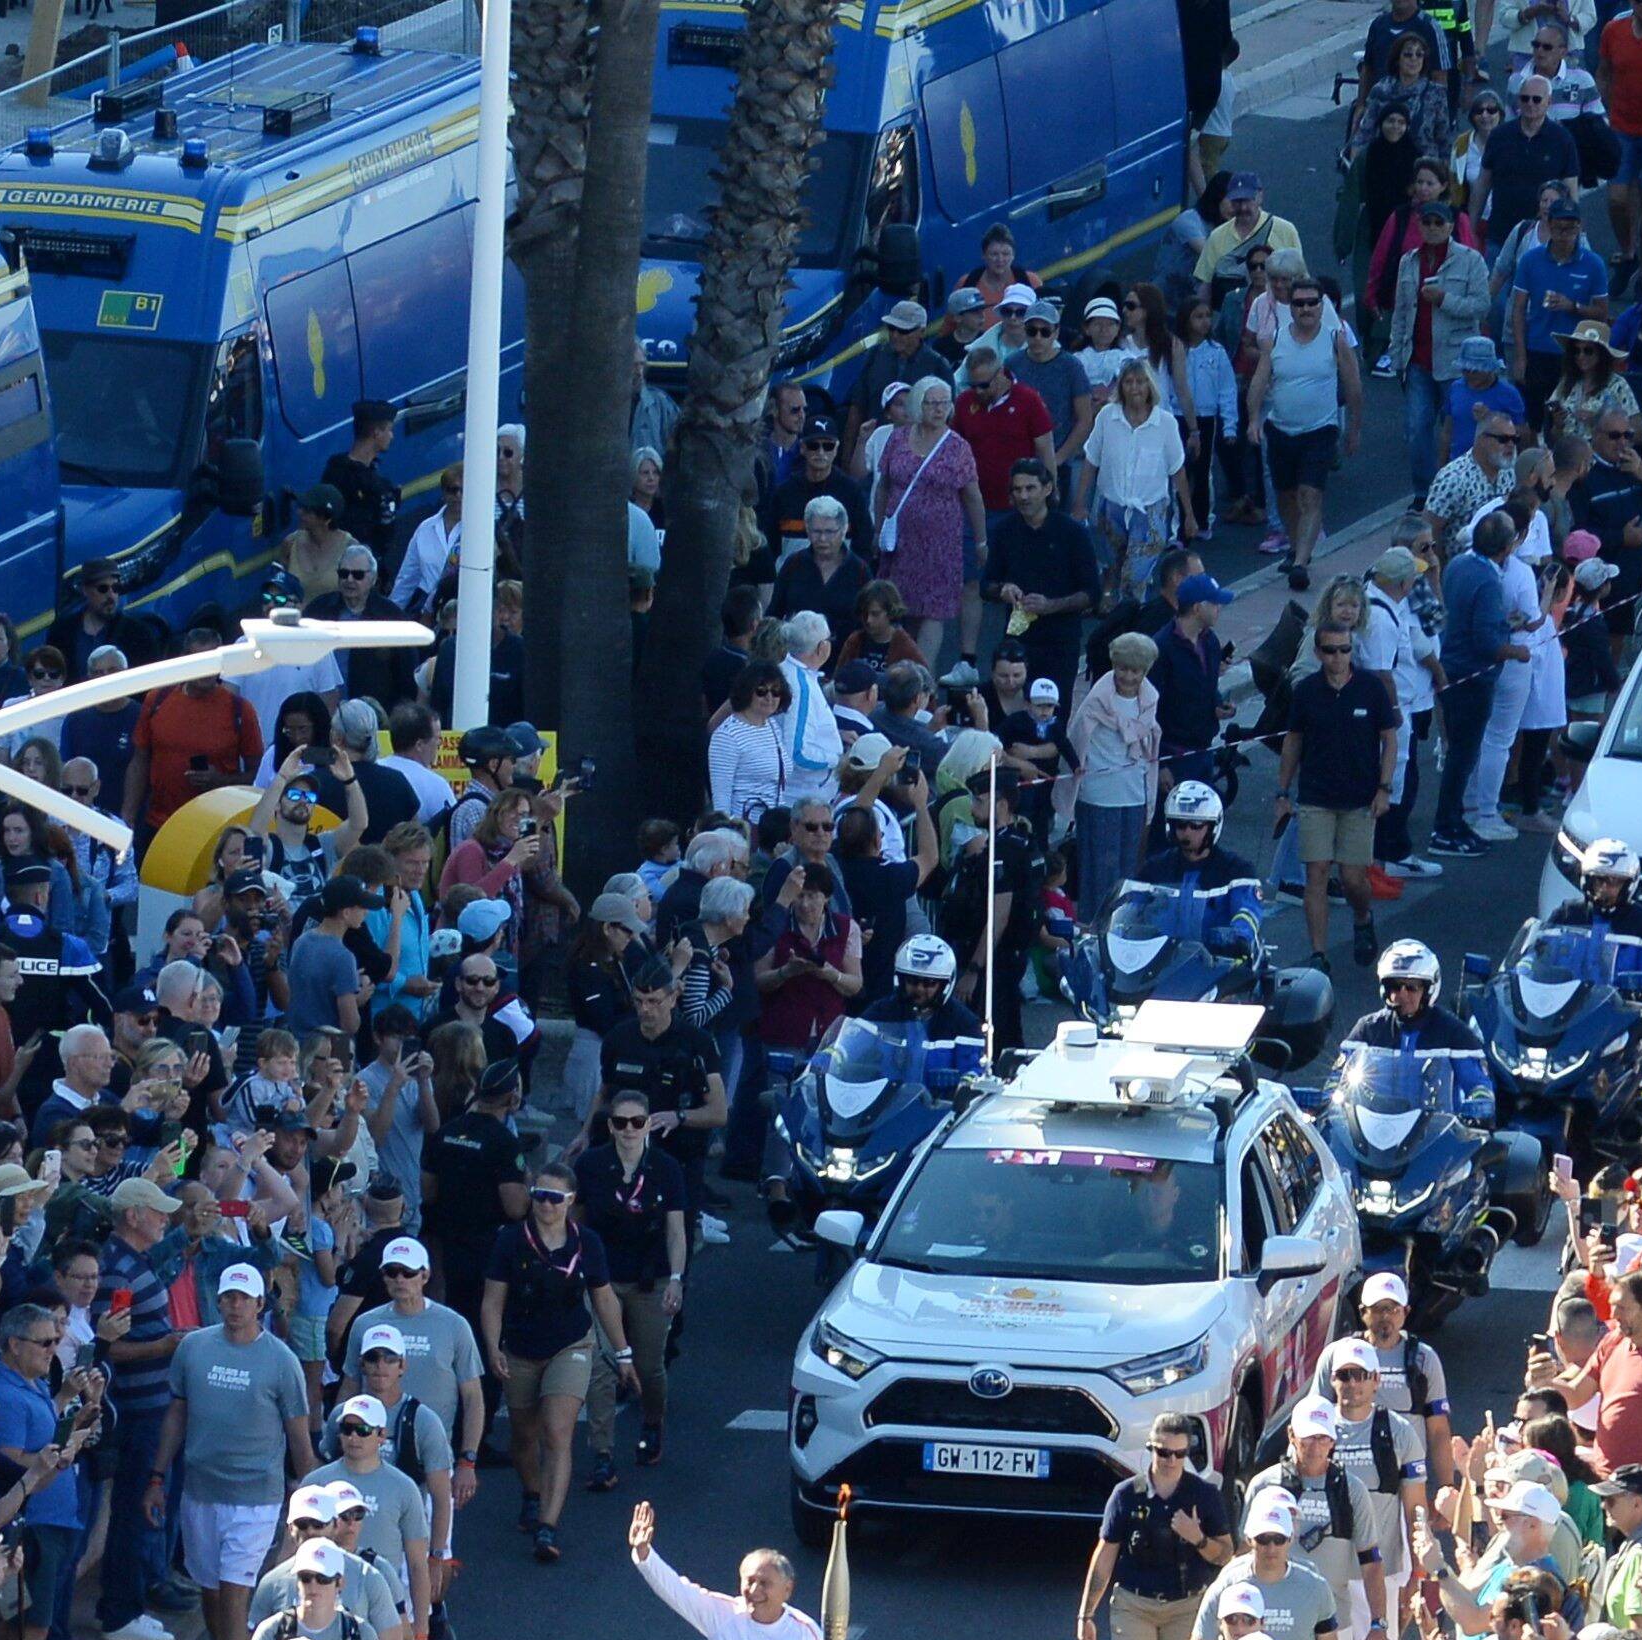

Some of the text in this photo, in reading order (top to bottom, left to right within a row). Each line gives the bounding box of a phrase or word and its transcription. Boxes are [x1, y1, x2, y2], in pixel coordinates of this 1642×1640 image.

[350, 127, 432, 185] GENDARMERIE
[8, 190, 157, 213] GENDARMERIE
[136, 296, 156, 311] B1
[19, 960, 58, 973] LICE
